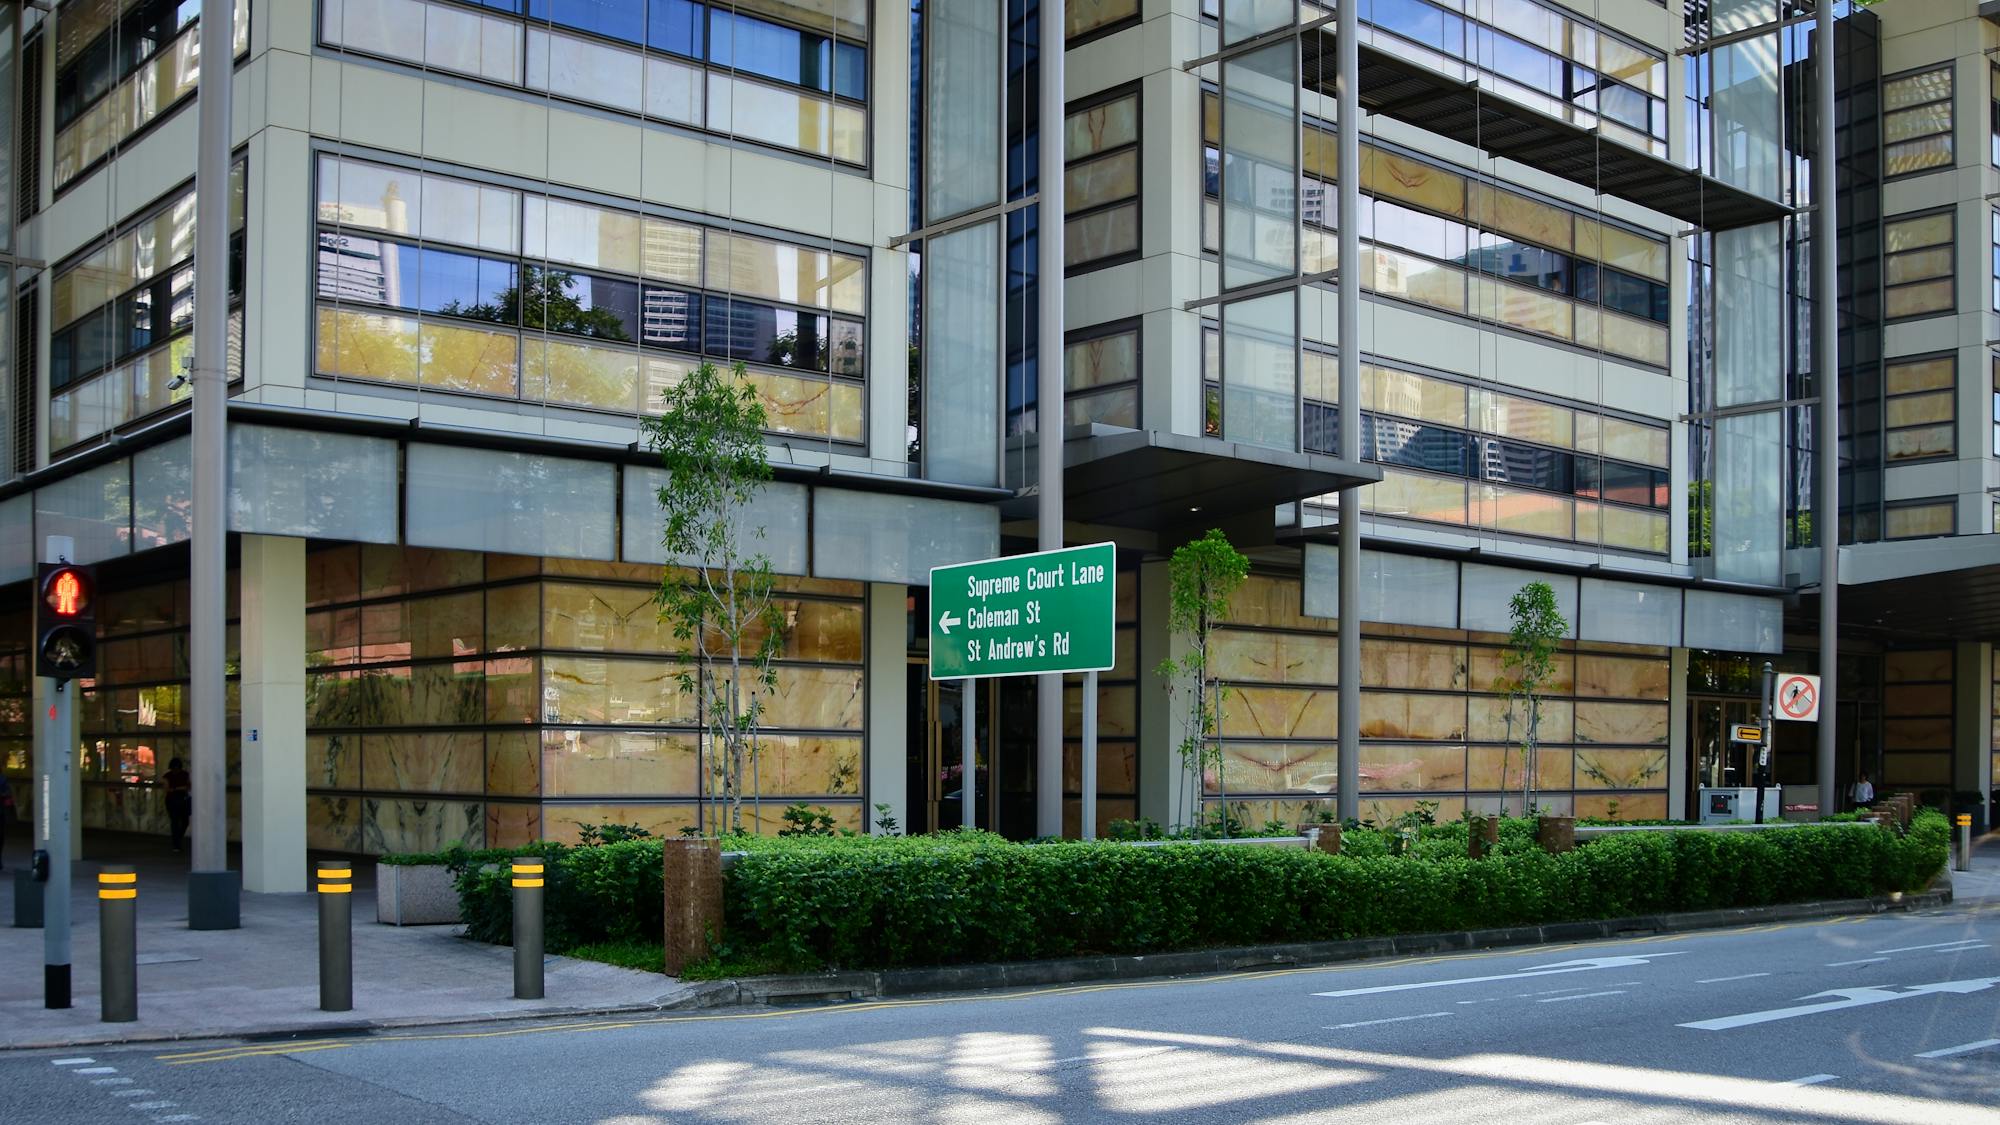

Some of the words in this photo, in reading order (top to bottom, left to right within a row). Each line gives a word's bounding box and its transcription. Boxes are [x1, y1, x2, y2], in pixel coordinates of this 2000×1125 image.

[967, 575, 1020, 602] Supreme
[1027, 563, 1064, 591] Court
[1072, 562, 1104, 585] Lane
[967, 606, 1019, 630] Coleman
[1026, 600, 1041, 624] St
[967, 639, 981, 662] St
[988, 635, 1046, 661] Andrew's
[1053, 632, 1070, 656] Rd
